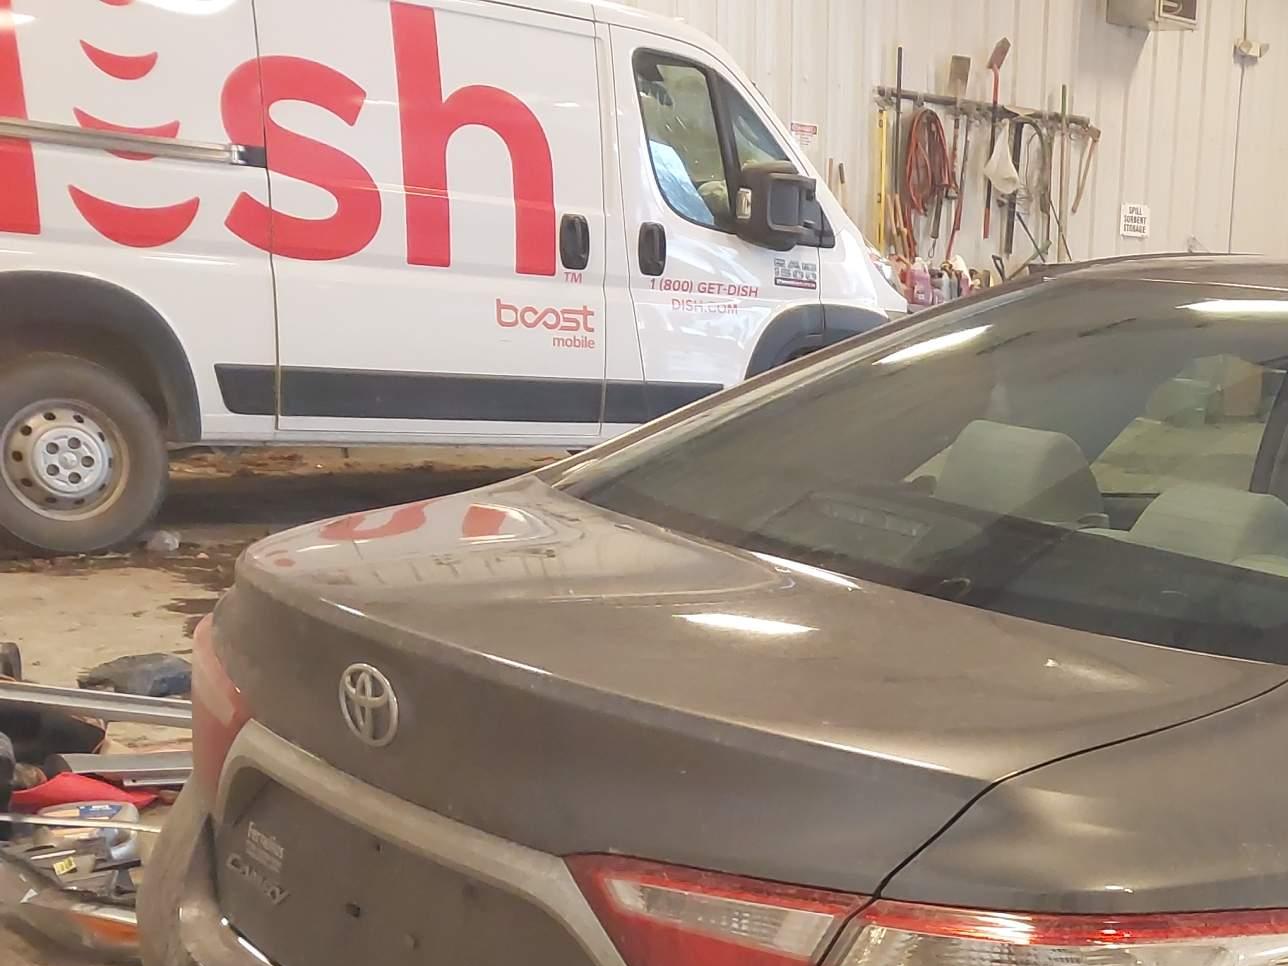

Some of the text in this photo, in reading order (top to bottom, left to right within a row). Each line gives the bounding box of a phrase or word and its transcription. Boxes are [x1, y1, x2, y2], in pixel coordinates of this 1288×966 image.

[564, 271, 583, 284] TM
[650, 278, 656, 290] 1
[660, 278, 693, 293] (800)
[697, 281, 759, 297] GET-DISH
[671, 298, 738, 315] DISH.COM
[496, 298, 594, 333] boost
[552, 335, 595, 349] mobile
